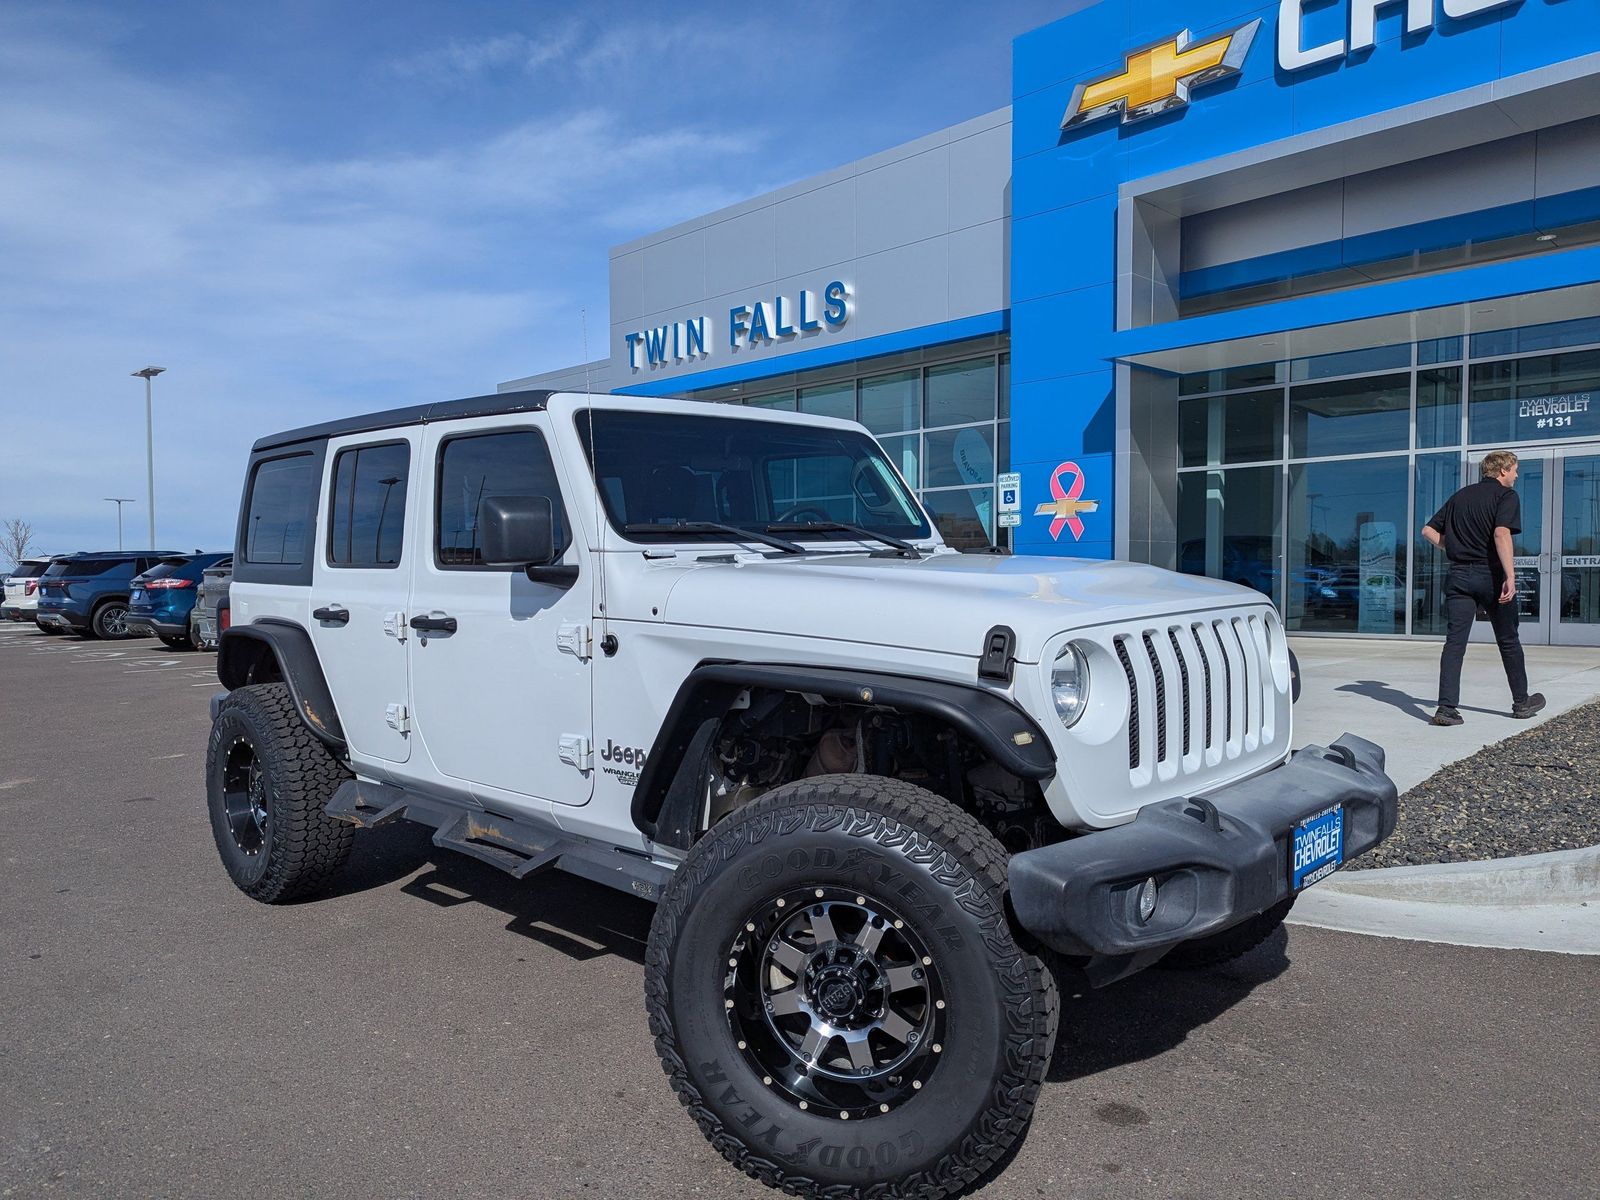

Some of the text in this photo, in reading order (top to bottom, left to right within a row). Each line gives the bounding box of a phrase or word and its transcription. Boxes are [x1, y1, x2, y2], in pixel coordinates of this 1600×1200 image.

[625, 281, 848, 369] TWIN FALLS
[1519, 400, 1590, 418] CHEVROLET
[1520, 394, 1590, 407] TWINFALLS
[1536, 416, 1572, 429] #131
[601, 739, 646, 770] Jeep
[602, 766, 640, 778] WRANGLE
[1295, 817, 1341, 850] TWINFALLS
[1294, 828, 1340, 872] CHEVROLET
